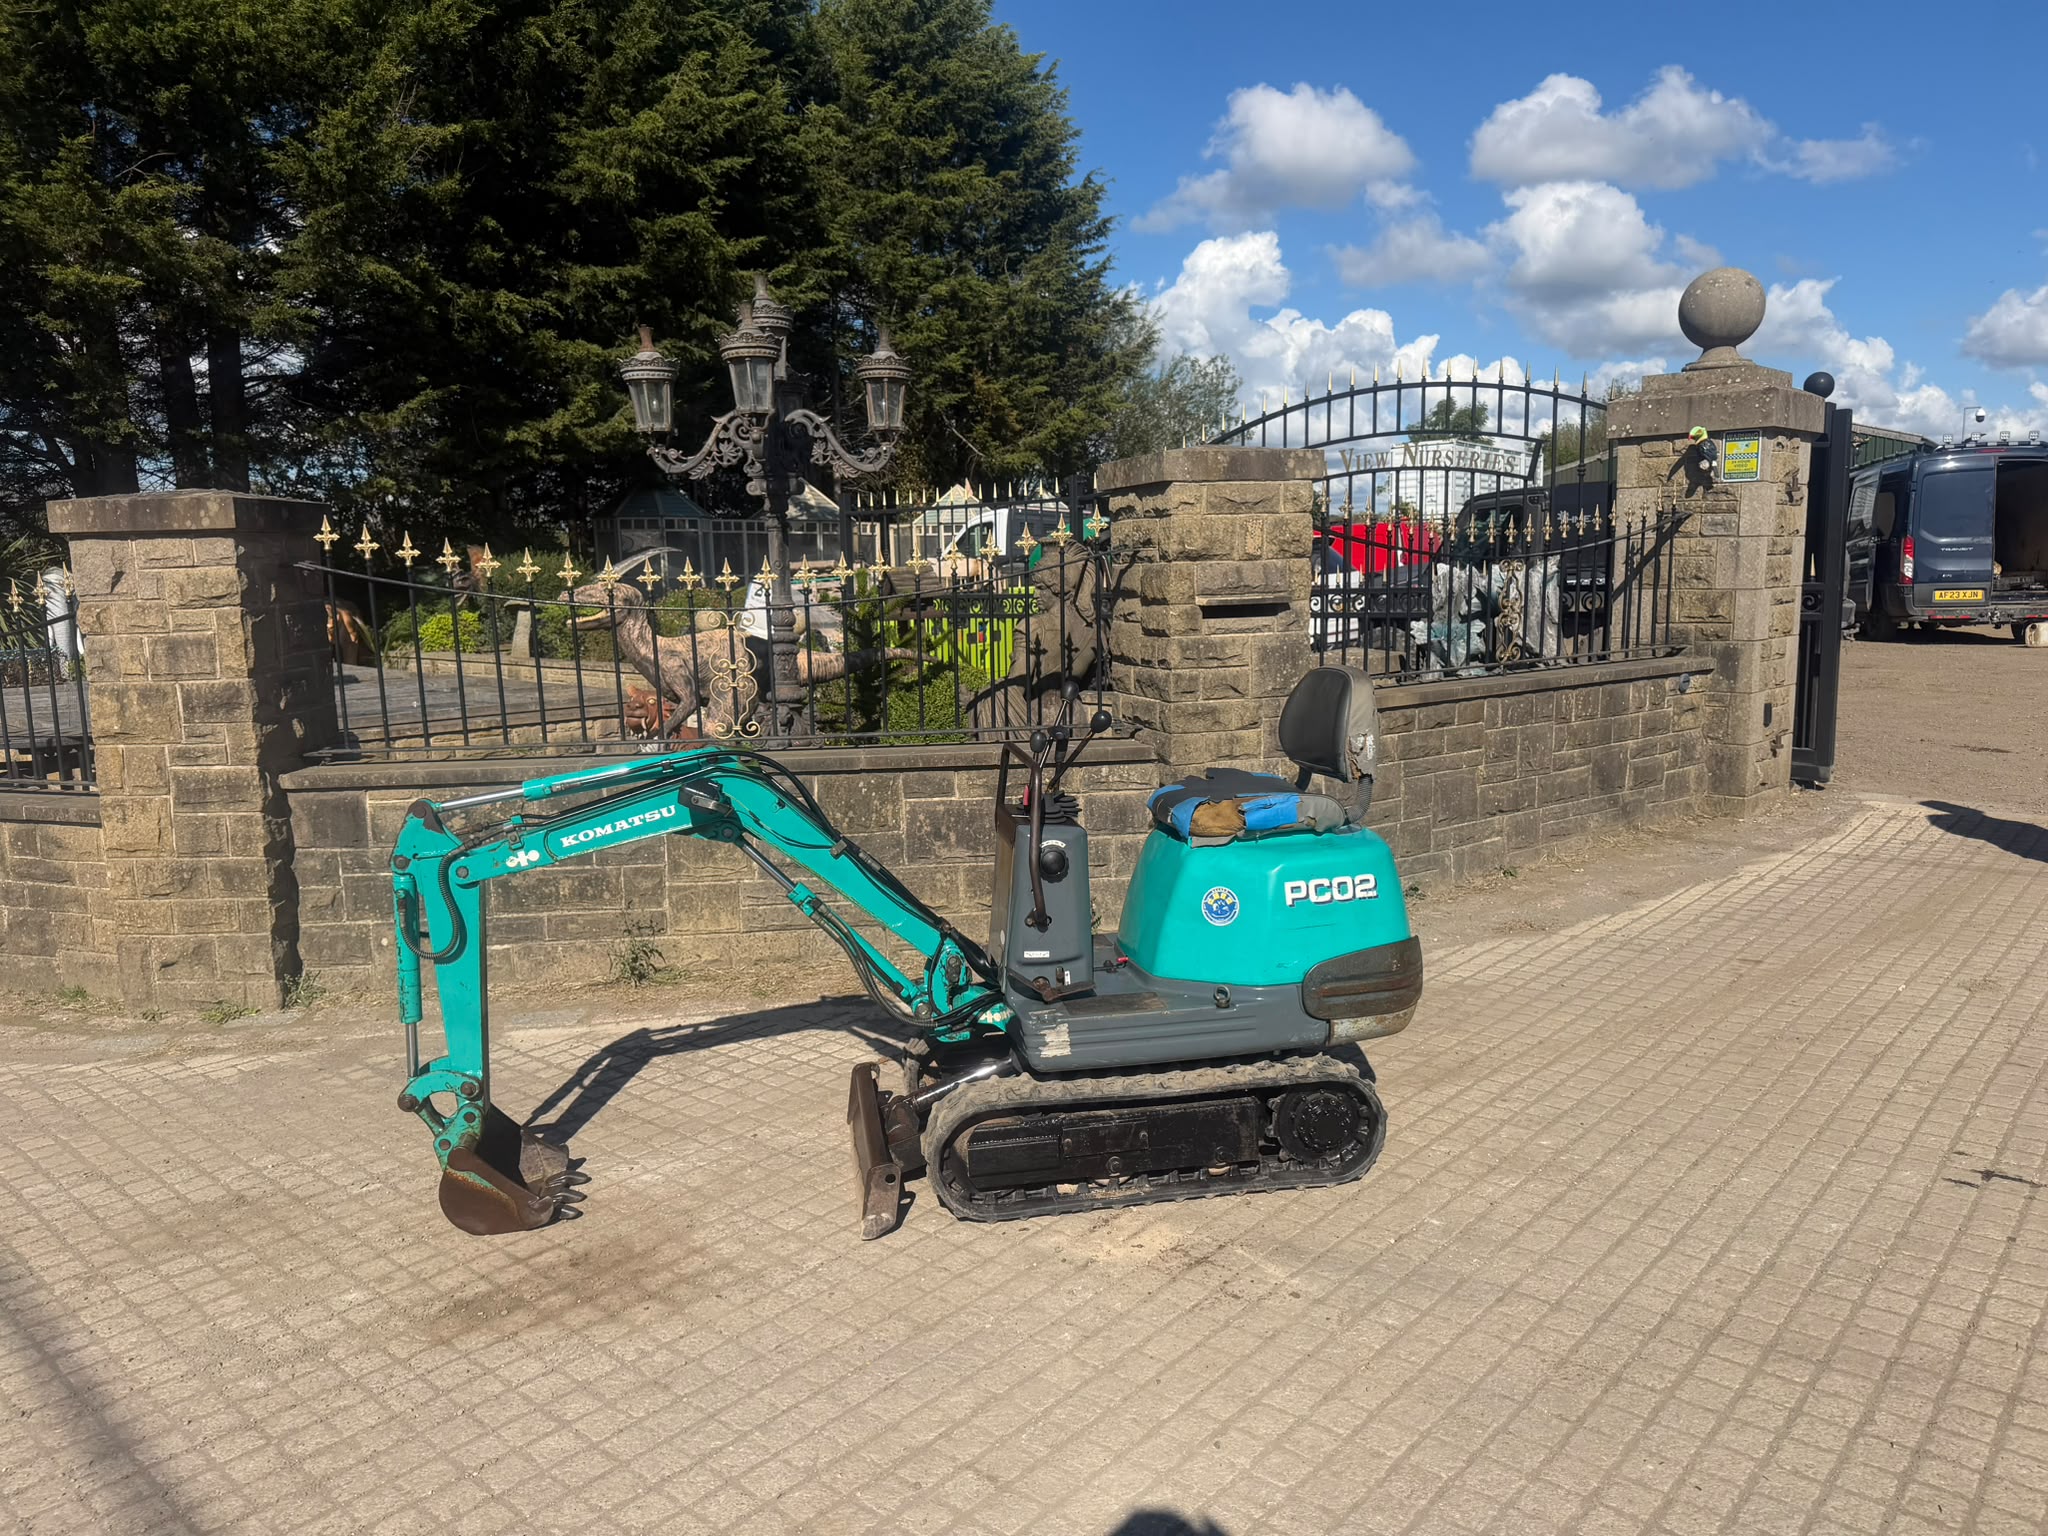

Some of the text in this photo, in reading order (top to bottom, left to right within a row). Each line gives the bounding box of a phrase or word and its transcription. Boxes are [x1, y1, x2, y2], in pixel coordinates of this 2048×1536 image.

[1402, 443, 1518, 474] NURSERIES
[1938, 591, 1960, 599] AF23
[560, 804, 677, 848] KOMATSU
[1284, 873, 1379, 907] PC02
